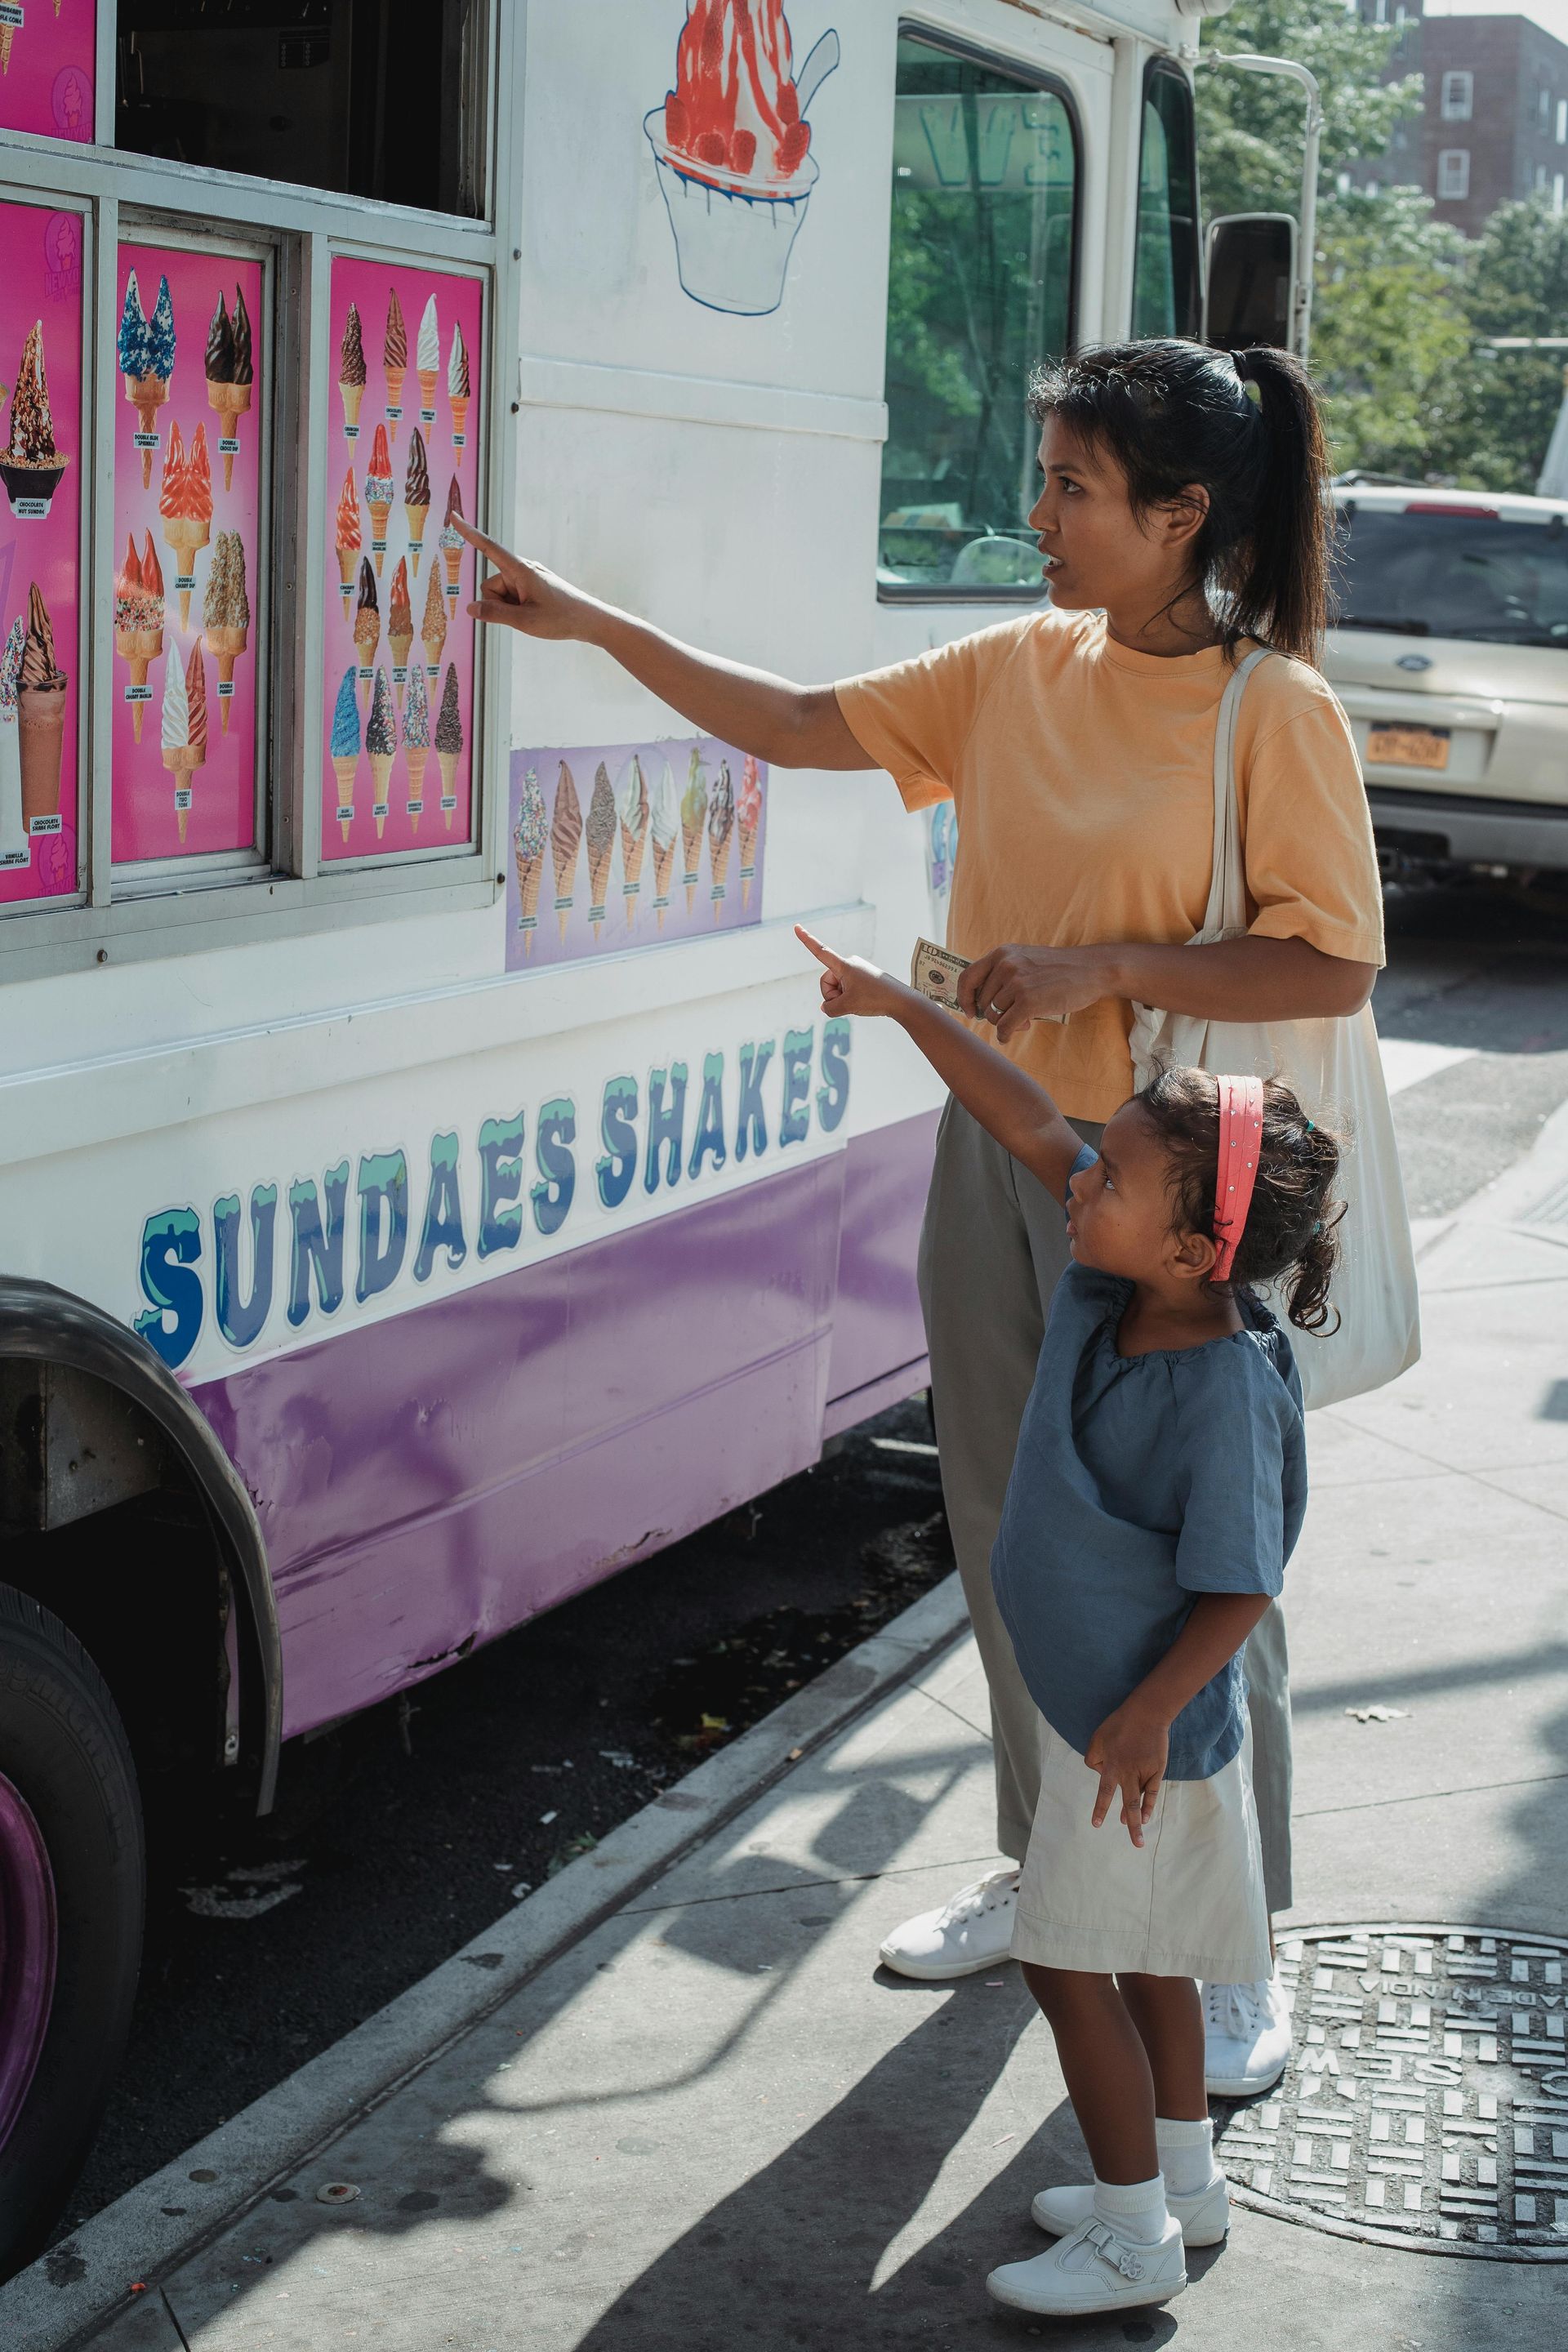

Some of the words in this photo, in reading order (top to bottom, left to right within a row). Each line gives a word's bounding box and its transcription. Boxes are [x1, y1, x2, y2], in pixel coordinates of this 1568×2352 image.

[9, 16, 22, 25] CONE
[34, 818, 59, 826] CHOCOLATE
[134, 1098, 577, 1371] SUNDAES
[596, 1018, 851, 1209] SHAKES
